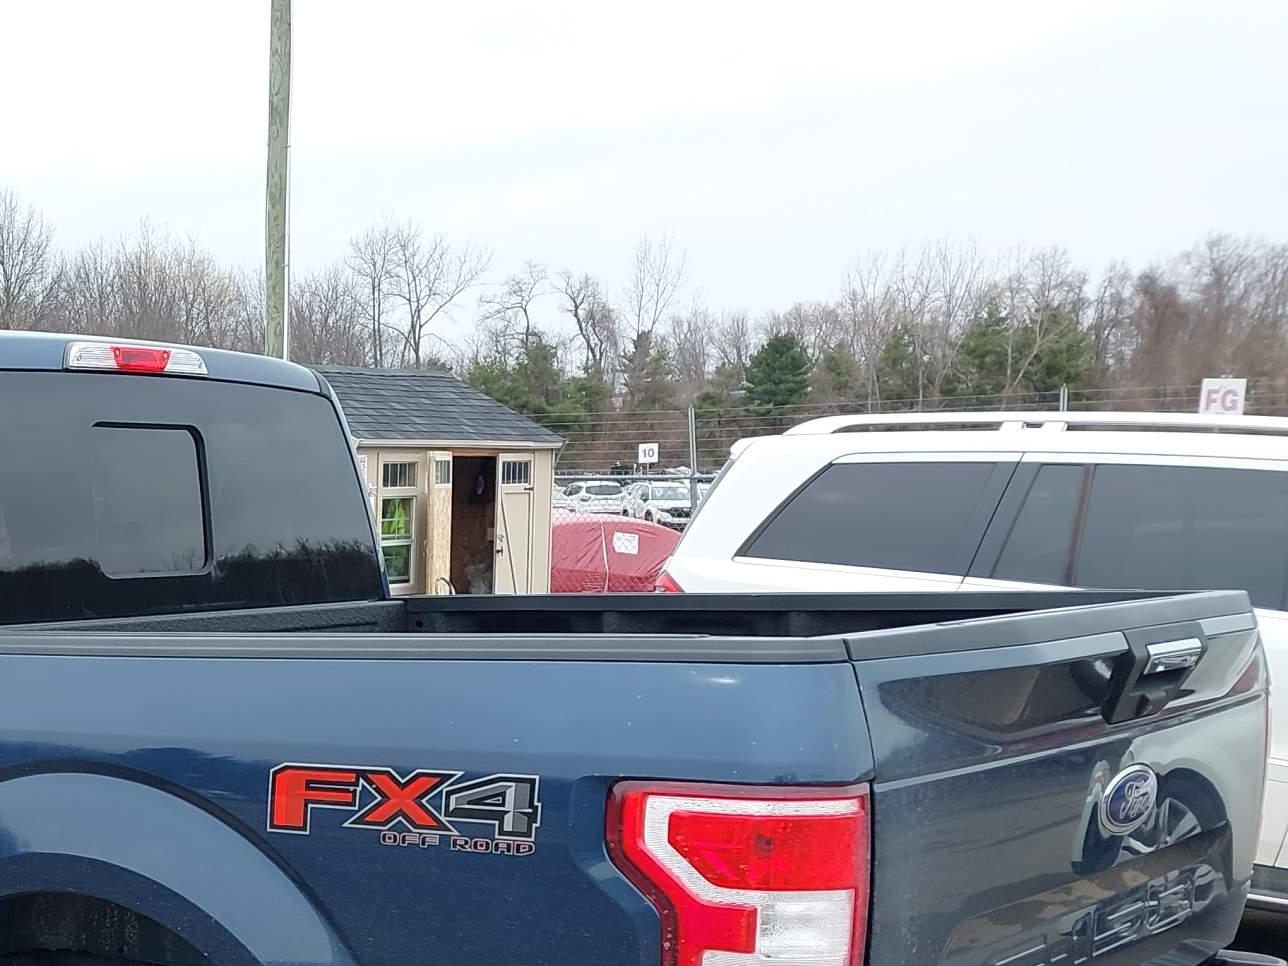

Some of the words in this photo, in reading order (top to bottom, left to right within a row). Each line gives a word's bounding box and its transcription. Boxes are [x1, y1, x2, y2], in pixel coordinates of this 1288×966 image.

[1205, 388, 1240, 411] FG
[642, 448, 655, 458] 10
[267, 763, 541, 840] FX4
[380, 832, 439, 847] OFF
[451, 836, 535, 856] ROAD
